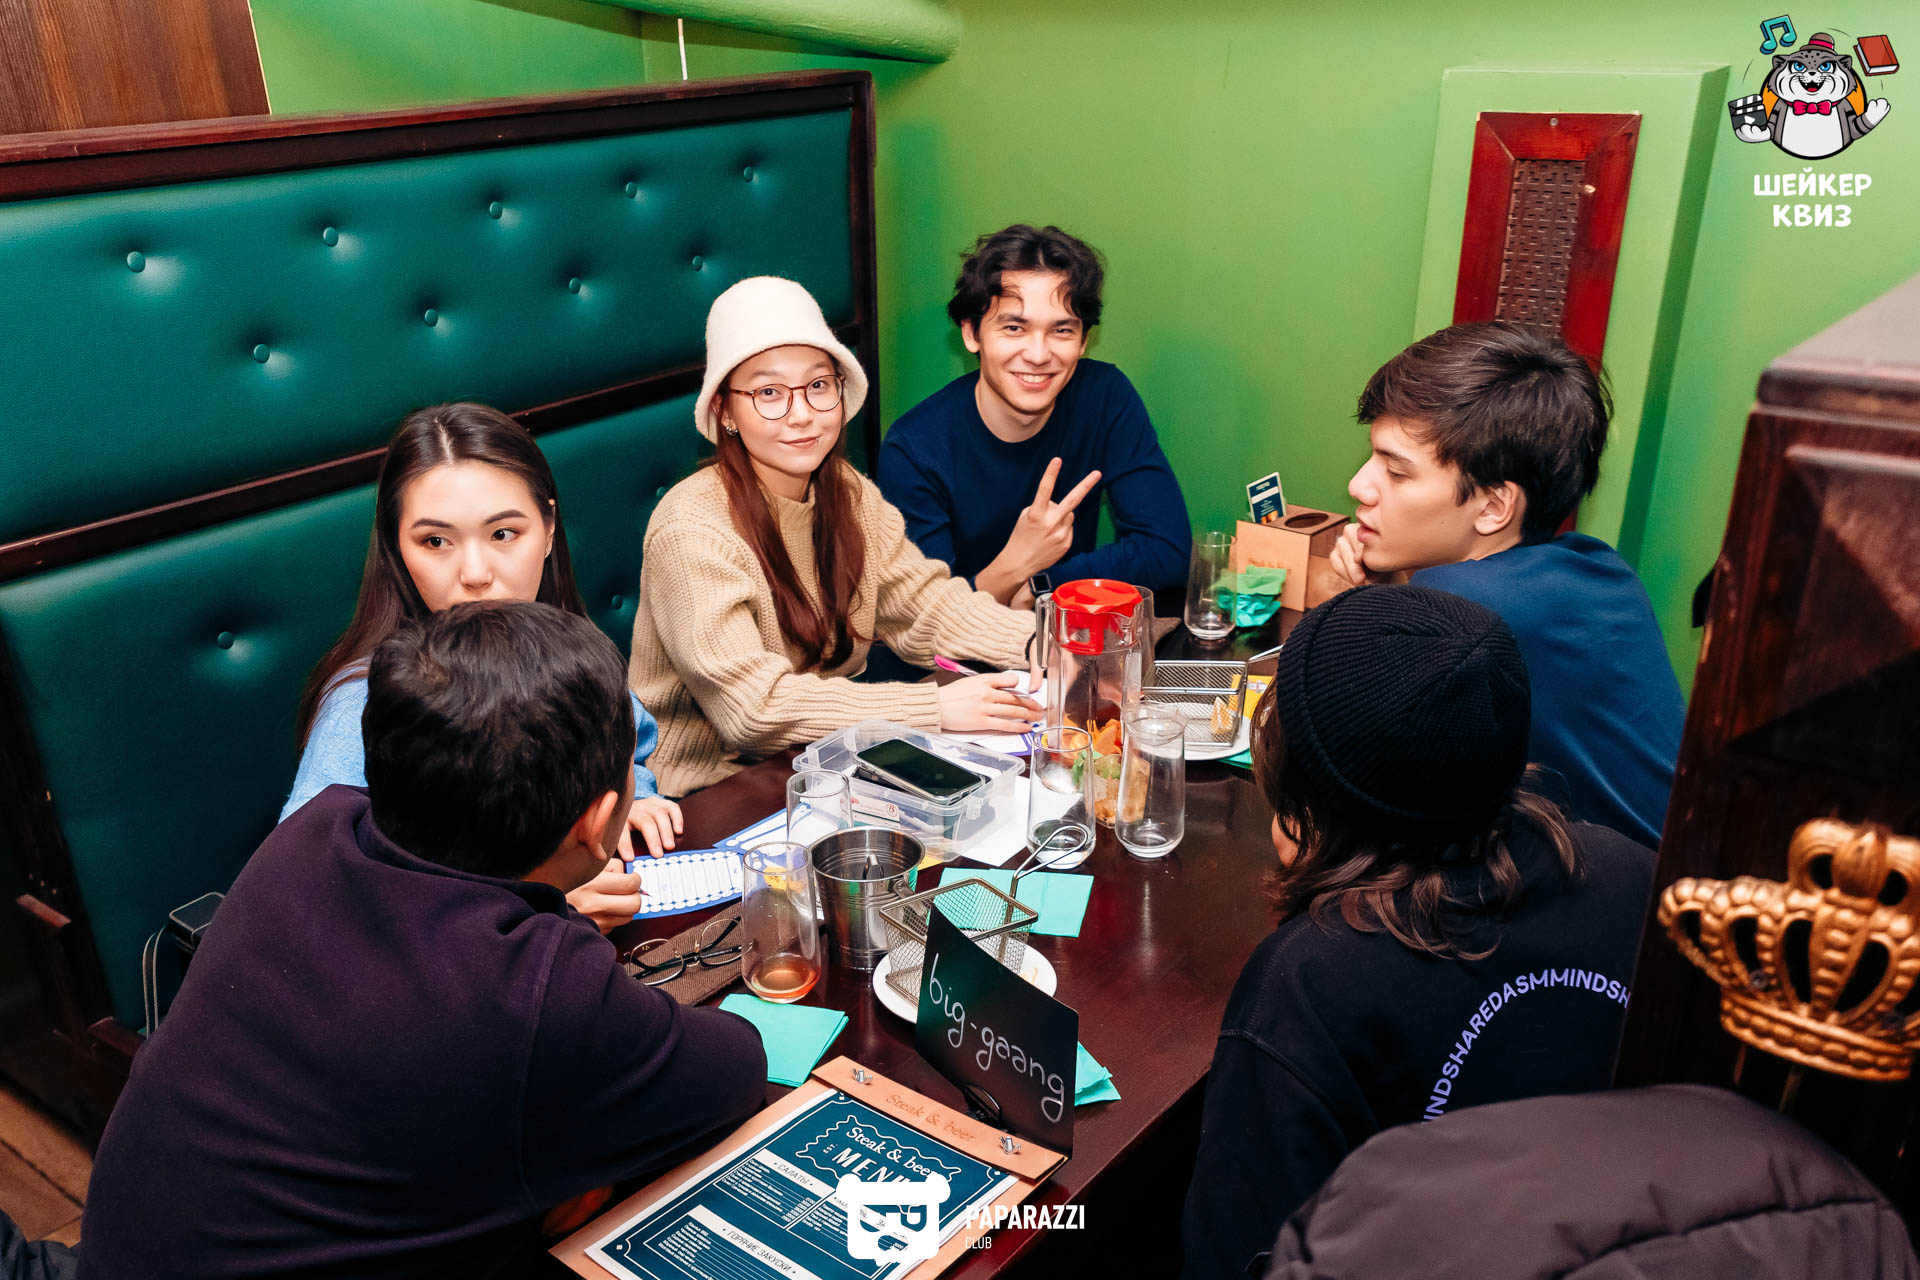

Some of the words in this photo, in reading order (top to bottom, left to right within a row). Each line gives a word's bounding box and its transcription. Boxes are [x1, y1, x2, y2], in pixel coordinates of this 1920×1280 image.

[1421, 968, 1631, 1123] INDSHAREDASMMINDSH
[886, 1094, 925, 1118] Steak
[925, 1113, 941, 1127] &
[944, 1121, 976, 1142] beer
[846, 1127, 886, 1154] Steak
[886, 1148, 903, 1163] &
[777, 1163, 811, 1185] САЛАТЫ
[727, 1230, 759, 1253] ГОРЯЧИЕ
[757, 1249, 792, 1272] ЗАКУСКИ
